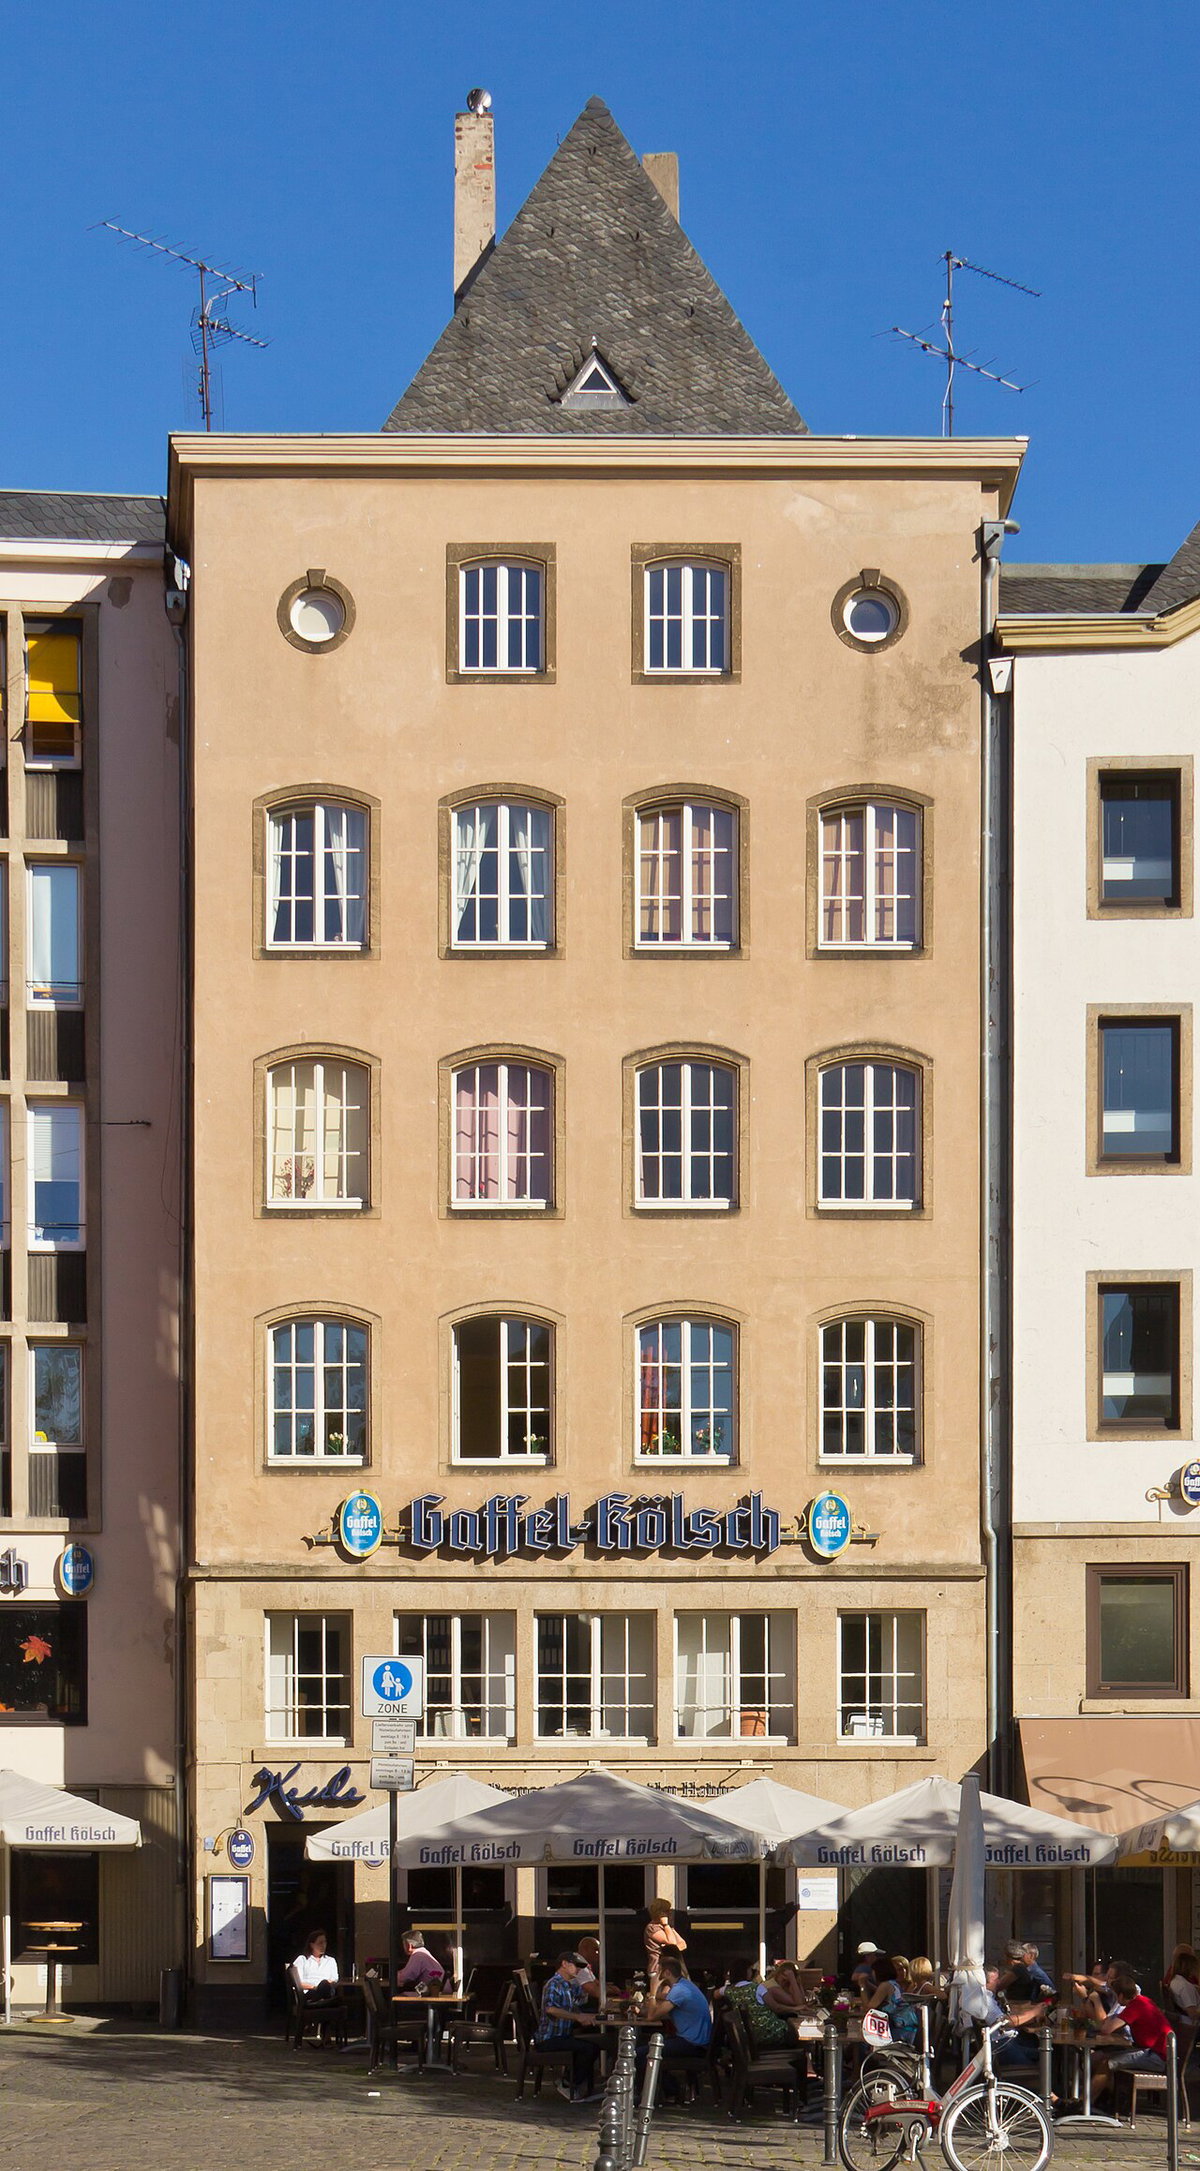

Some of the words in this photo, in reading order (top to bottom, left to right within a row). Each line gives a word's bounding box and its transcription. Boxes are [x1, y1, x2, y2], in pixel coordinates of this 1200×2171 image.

[346, 1515, 378, 1528] Gaffel
[410, 1491, 782, 1554] Gaffel-Kölsch
[815, 1516, 847, 1529] Gaffel
[377, 1703, 408, 1714] ZONE
[25, 1825, 66, 1842] Gaffel
[70, 1826, 116, 1841] Kölsch
[331, 1840, 376, 1857] Gaffel
[419, 1846, 466, 1864] Gaffel
[470, 1840, 521, 1862] Kölsch
[573, 1838, 620, 1857] Gaffel
[625, 1836, 677, 1856] Kölsch
[817, 1844, 867, 1864] Gaffel
[871, 1844, 926, 1864] Kölsch
[1036, 1844, 1091, 1863] Kölsch
[870, 2018, 885, 2034] DB
